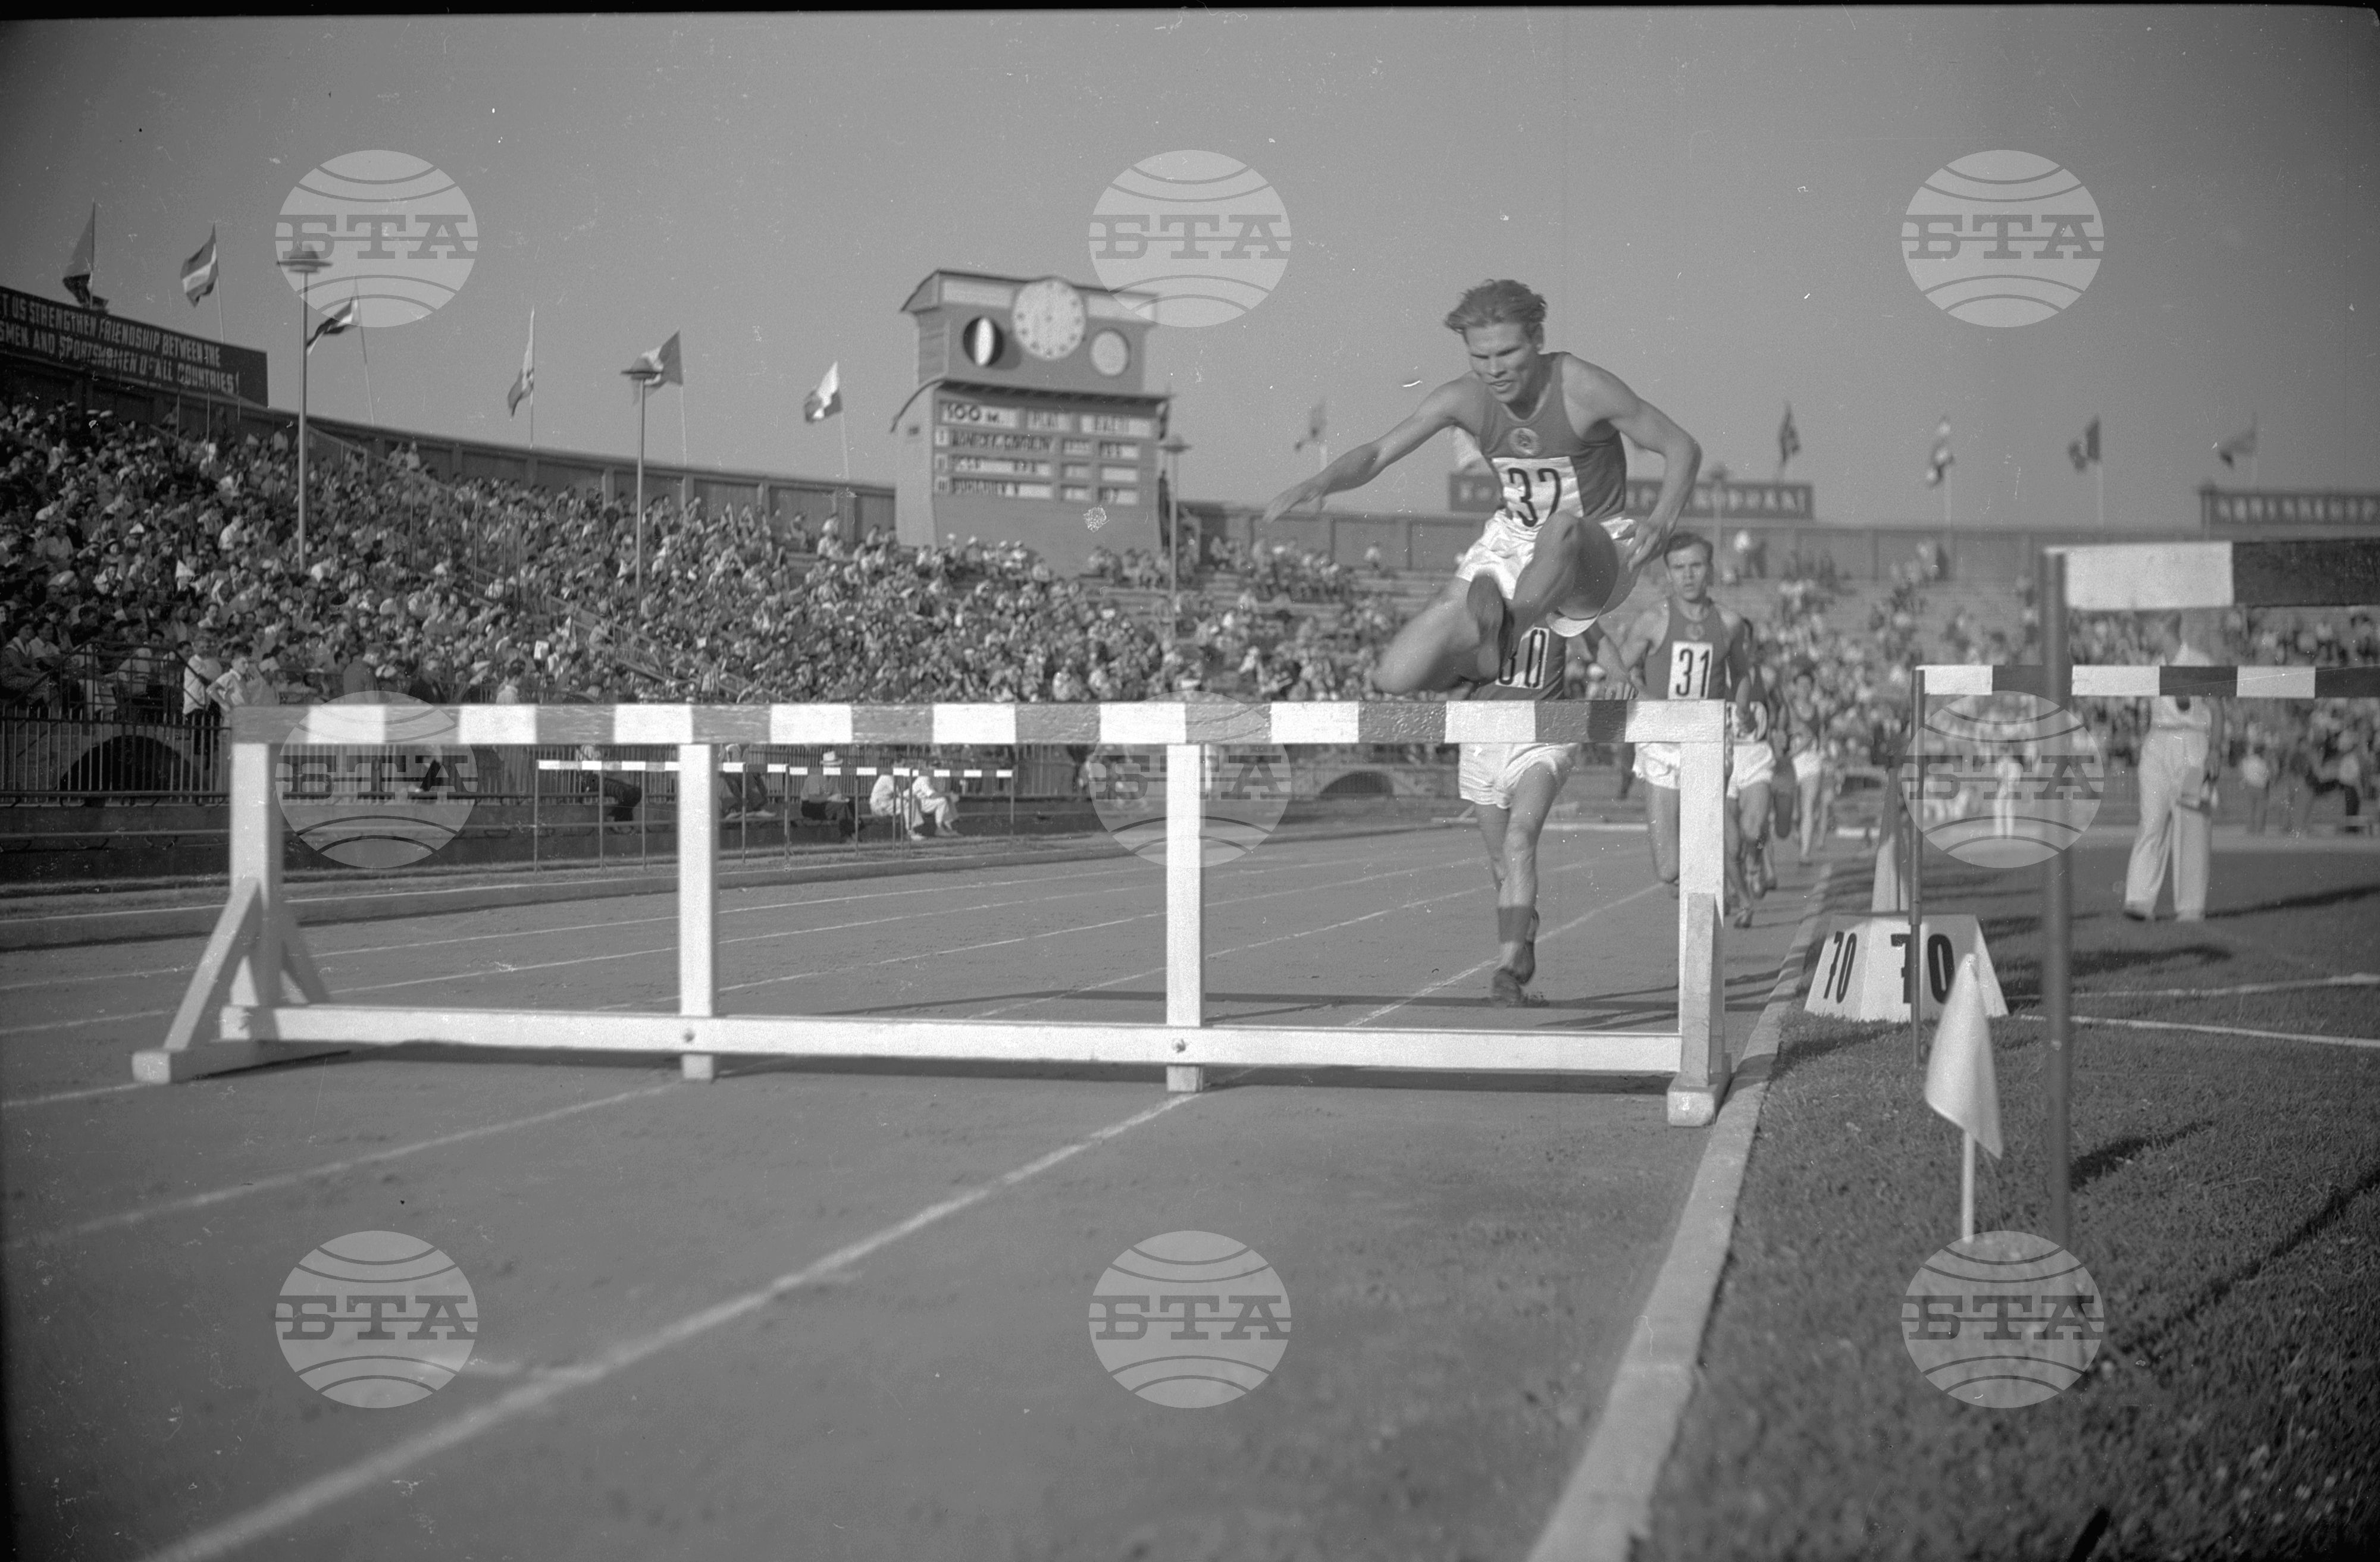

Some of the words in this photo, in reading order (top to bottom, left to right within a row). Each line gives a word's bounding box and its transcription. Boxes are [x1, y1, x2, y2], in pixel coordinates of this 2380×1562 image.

[12, 296, 26, 321] US
[29, 301, 97, 337] STRENGTHEN
[99, 318, 160, 352] FRIENDSHIP
[162, 333, 203, 364] BETWEEN
[204, 343, 221, 368] THE
[33, 329, 55, 355] AND
[59, 335, 137, 374] SPORTSWOMEN
[155, 358, 173, 382] ALL
[948, 403, 980, 421] 100
[1676, 648, 1709, 697] 31
